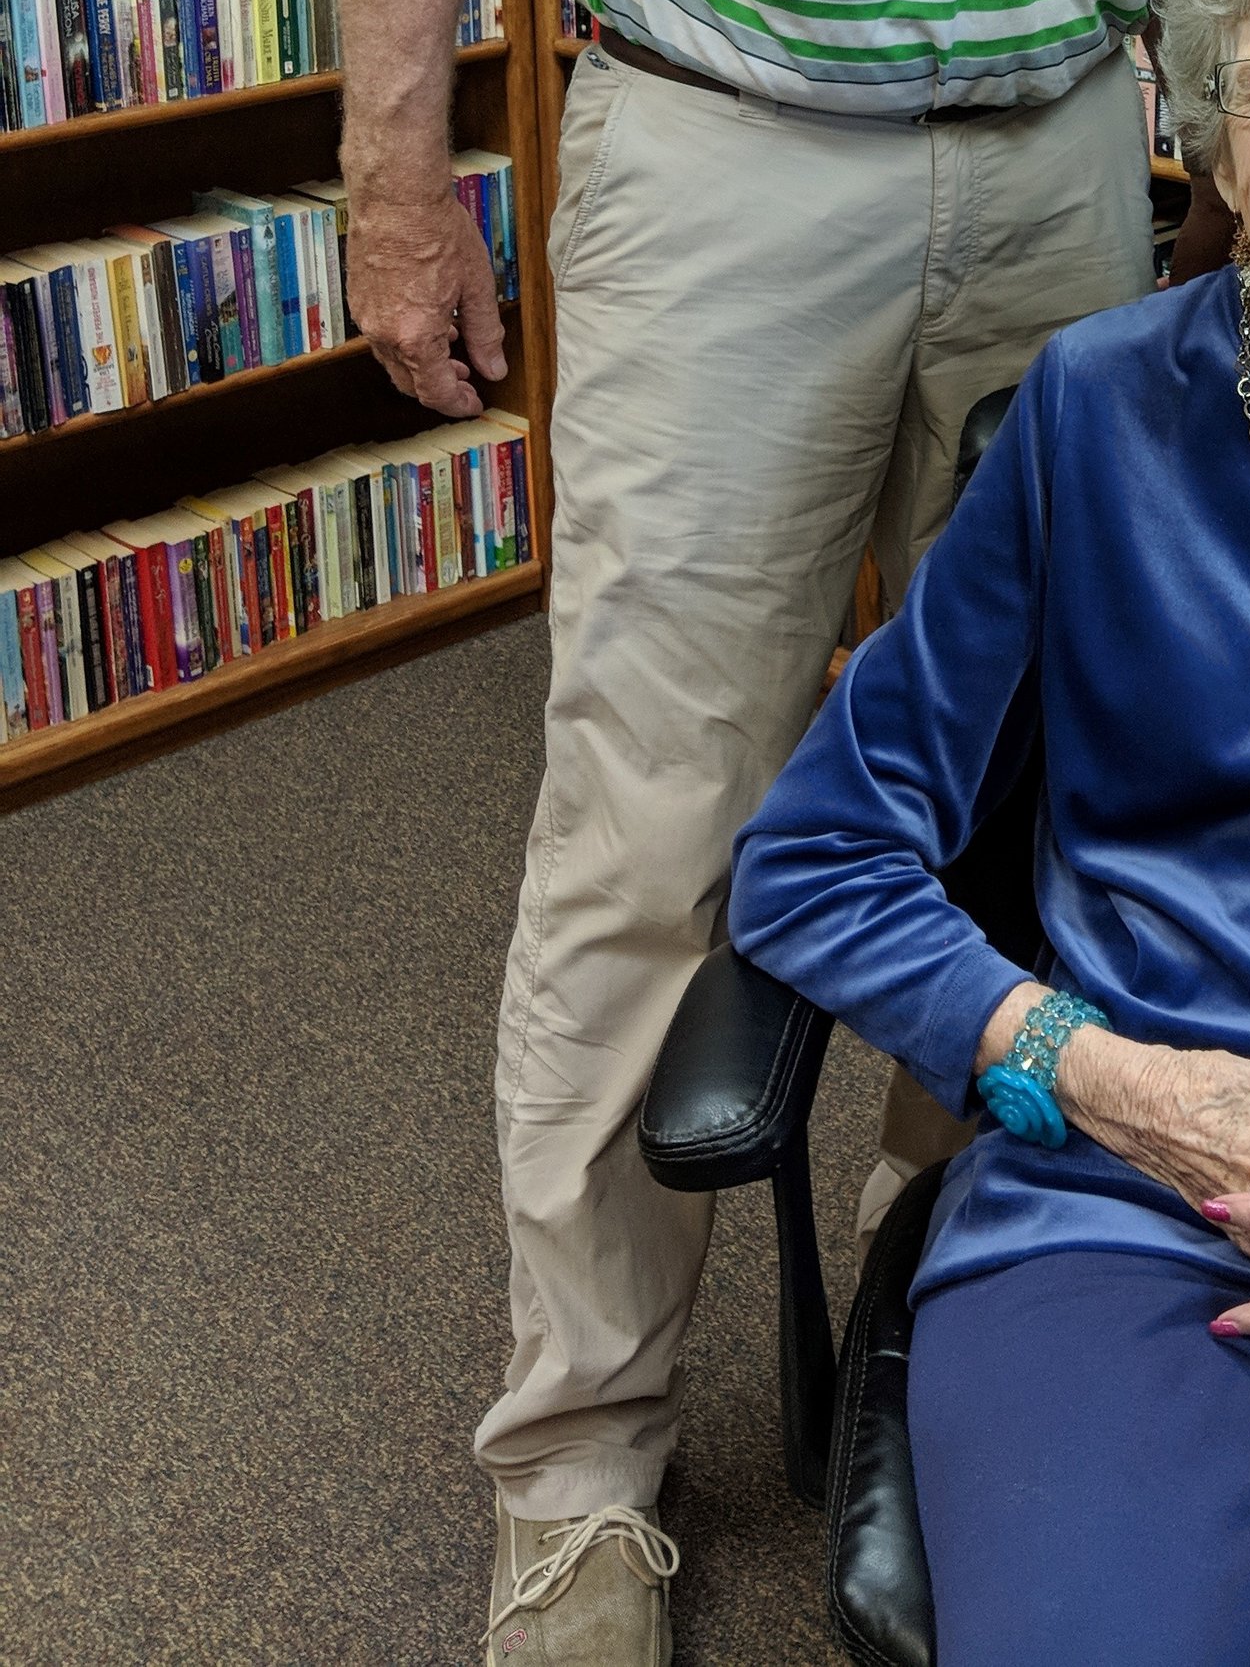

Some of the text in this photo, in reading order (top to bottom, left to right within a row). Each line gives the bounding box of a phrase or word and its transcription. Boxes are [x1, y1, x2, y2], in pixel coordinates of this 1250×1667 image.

[98, 8, 111, 35] PERRY
[260, 4, 272, 25] STEEL
[262, 28, 274, 54] MALICE
[204, 52, 214, 88] OR DARE
[211, 56, 220, 82] TRUTH
[201, 258, 209, 286] CAITLIN
[88, 268, 104, 344] THE PERFECT HUSBAND
